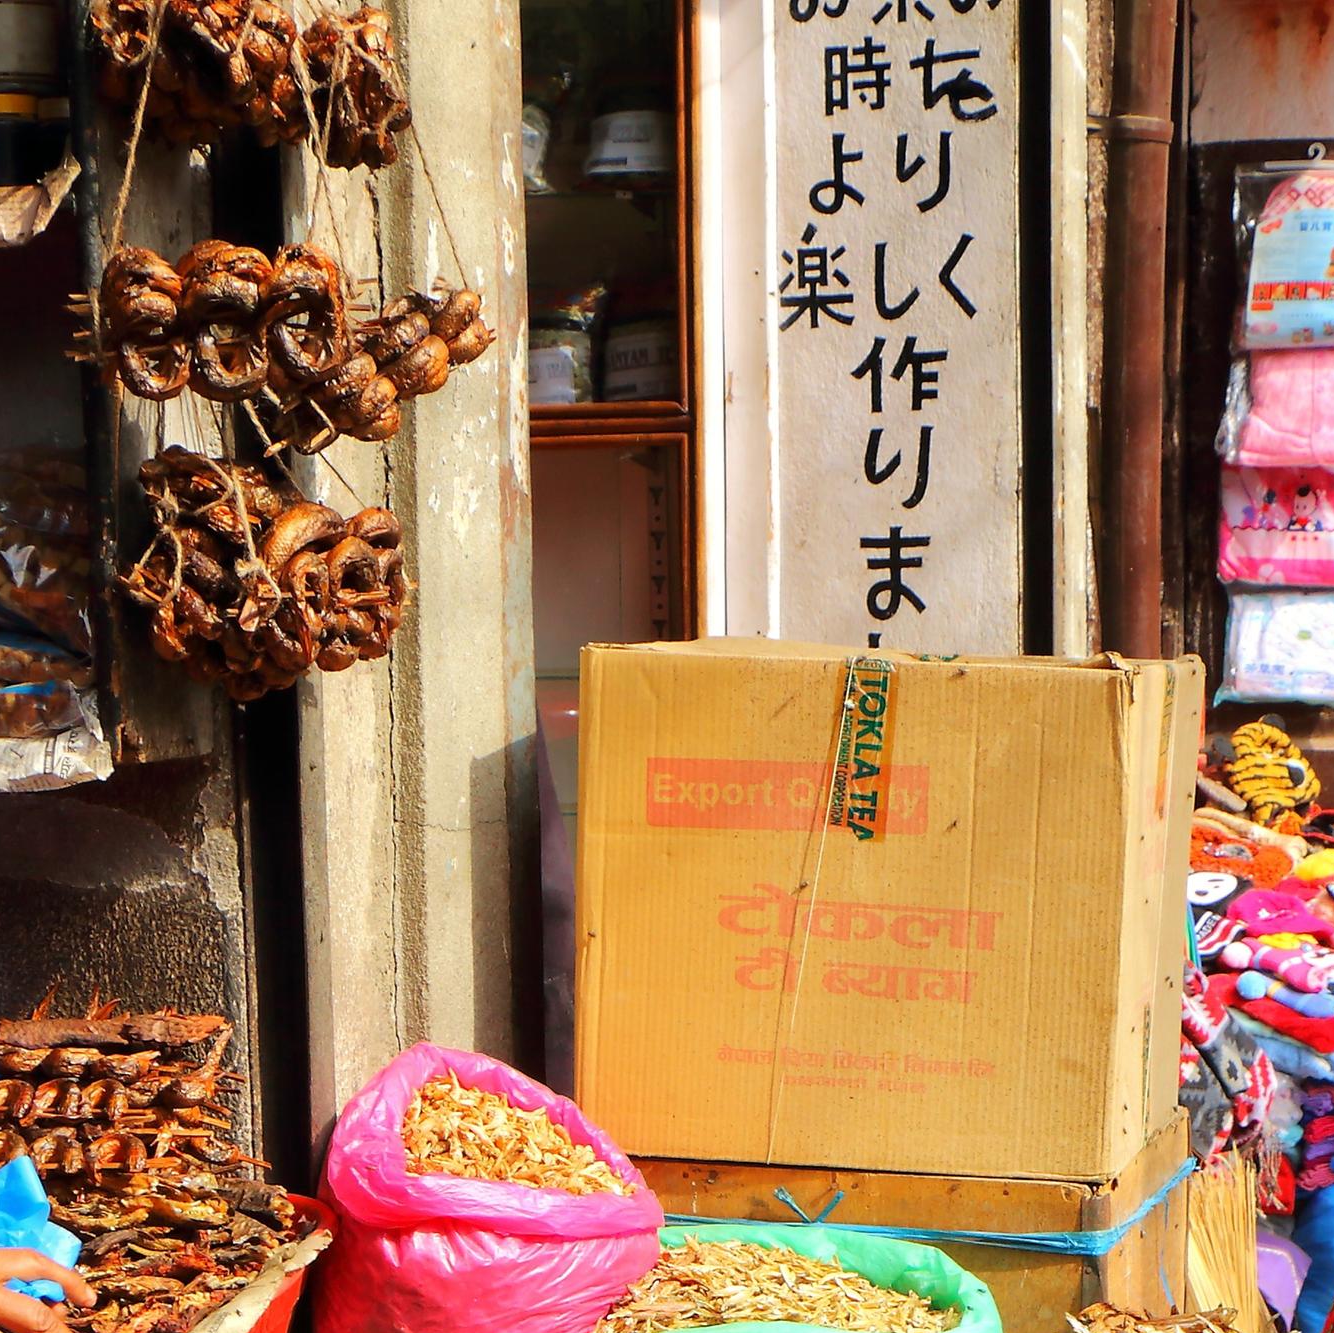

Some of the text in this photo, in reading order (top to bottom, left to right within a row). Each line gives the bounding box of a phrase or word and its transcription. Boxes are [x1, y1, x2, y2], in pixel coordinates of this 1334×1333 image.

[852, 673, 888, 781] TOKLA
[652, 773, 775, 810] Export
[846, 790, 879, 842] TEA
[718, 882, 1005, 951] टोकला
[735, 946, 979, 1005] टी ब्याग
